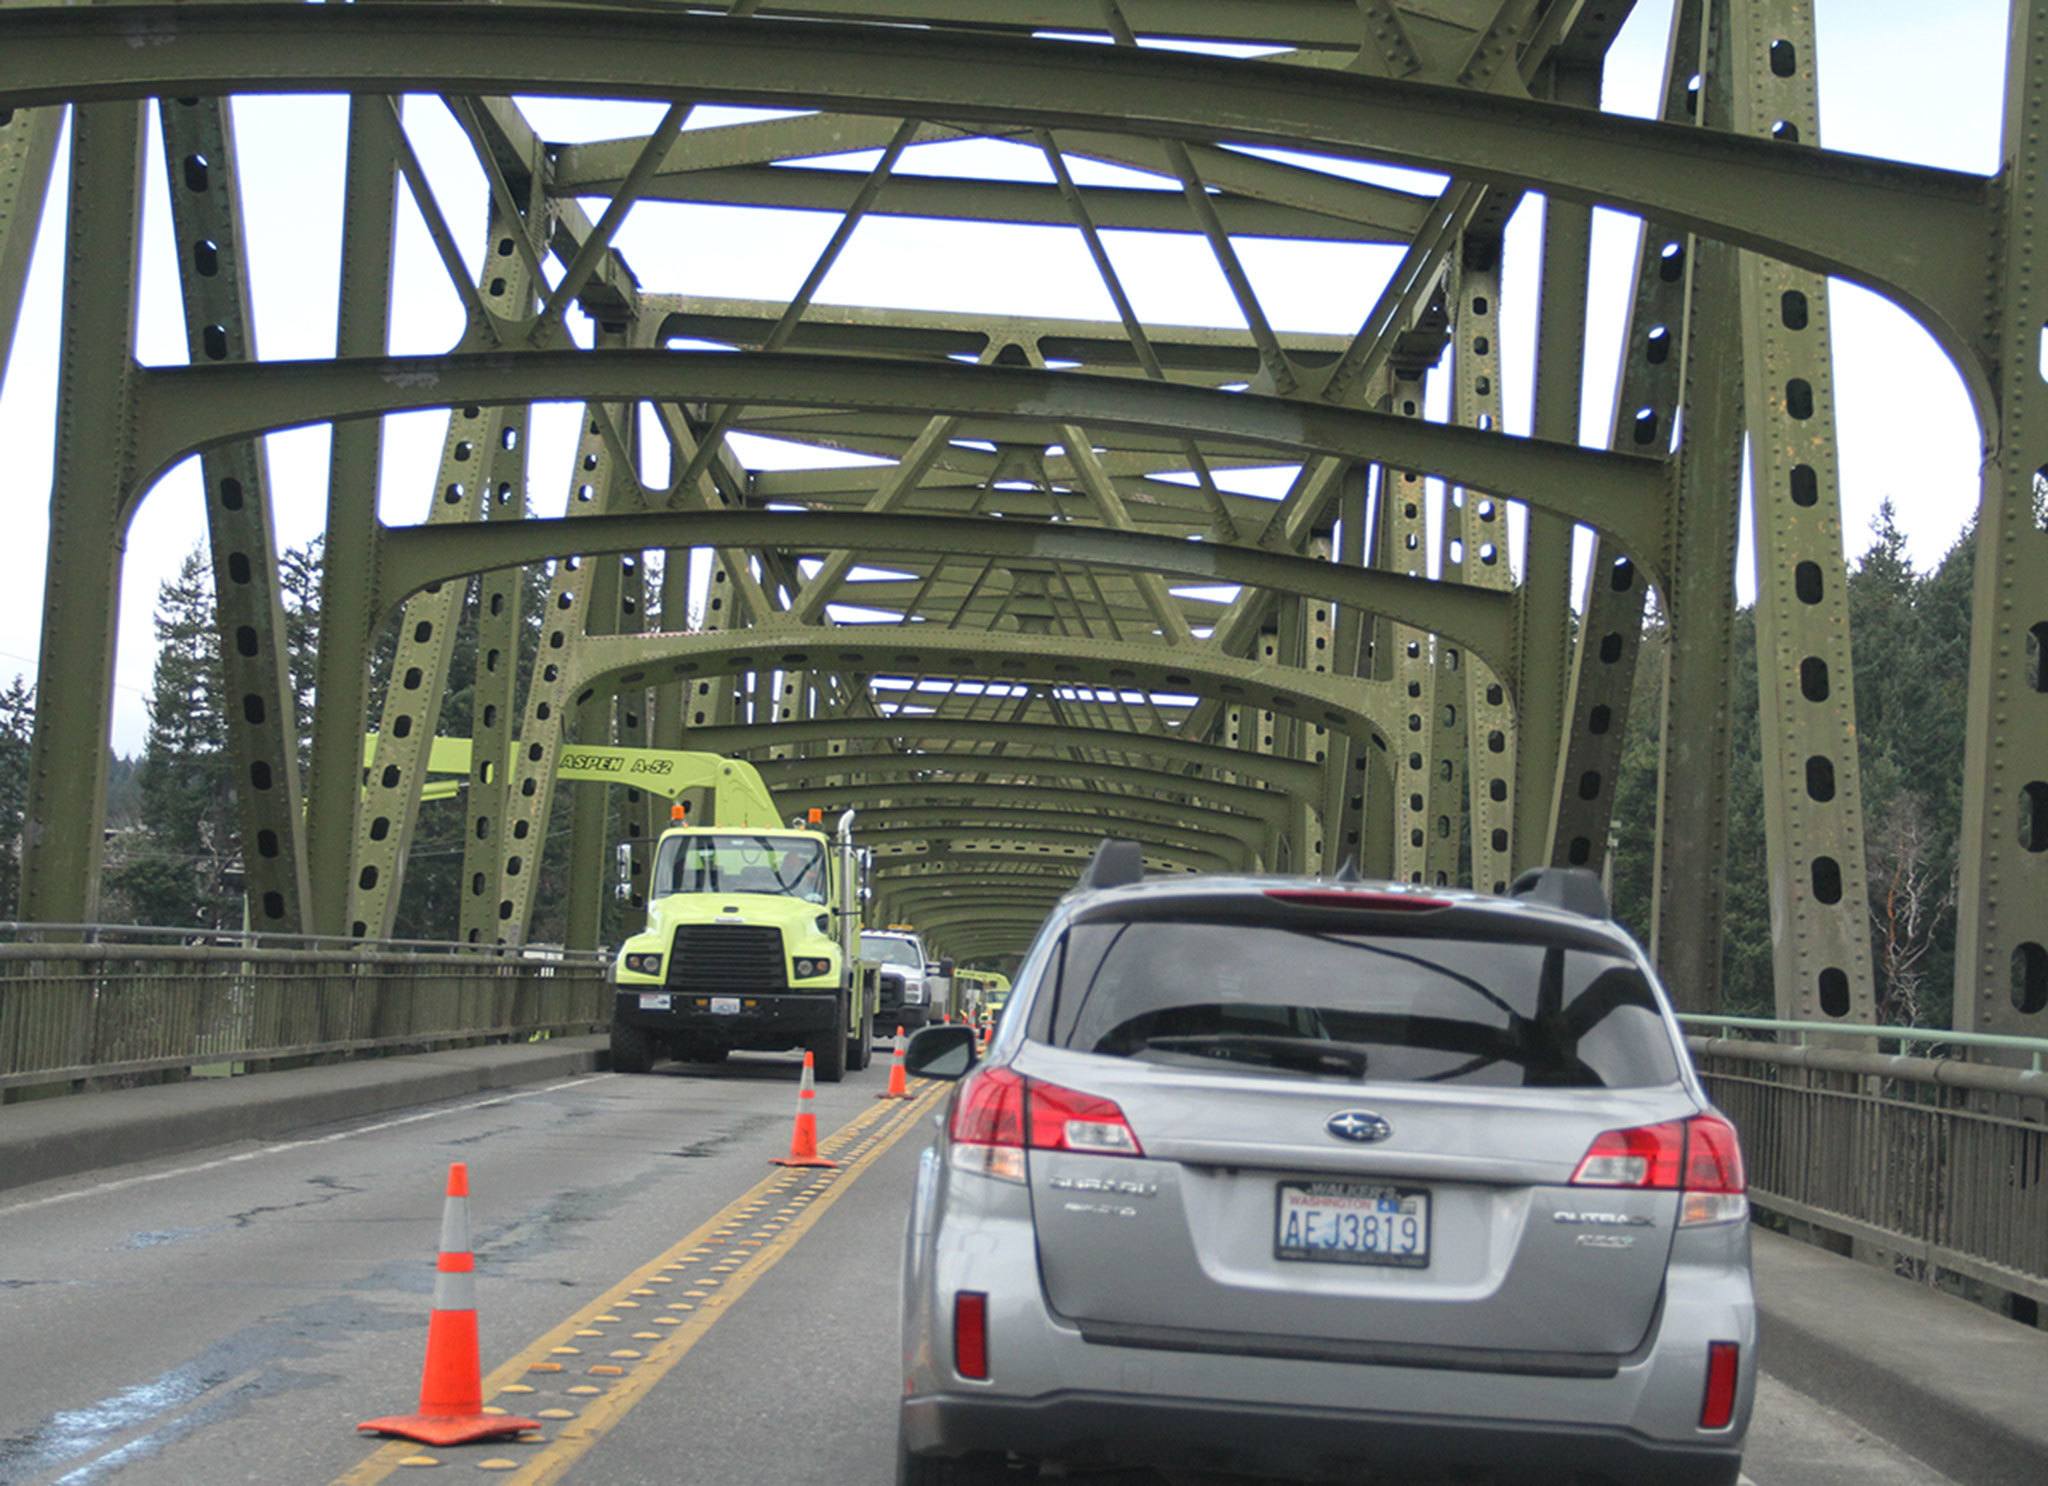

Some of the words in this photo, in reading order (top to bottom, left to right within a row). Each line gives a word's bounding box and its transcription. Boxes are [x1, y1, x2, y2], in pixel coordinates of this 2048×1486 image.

[560, 754, 624, 772] ASPEN
[630, 758, 674, 775] A-52
[1289, 1195, 1372, 1210] WASHINGTON
[1284, 1210, 1417, 1254] AEJ3819
